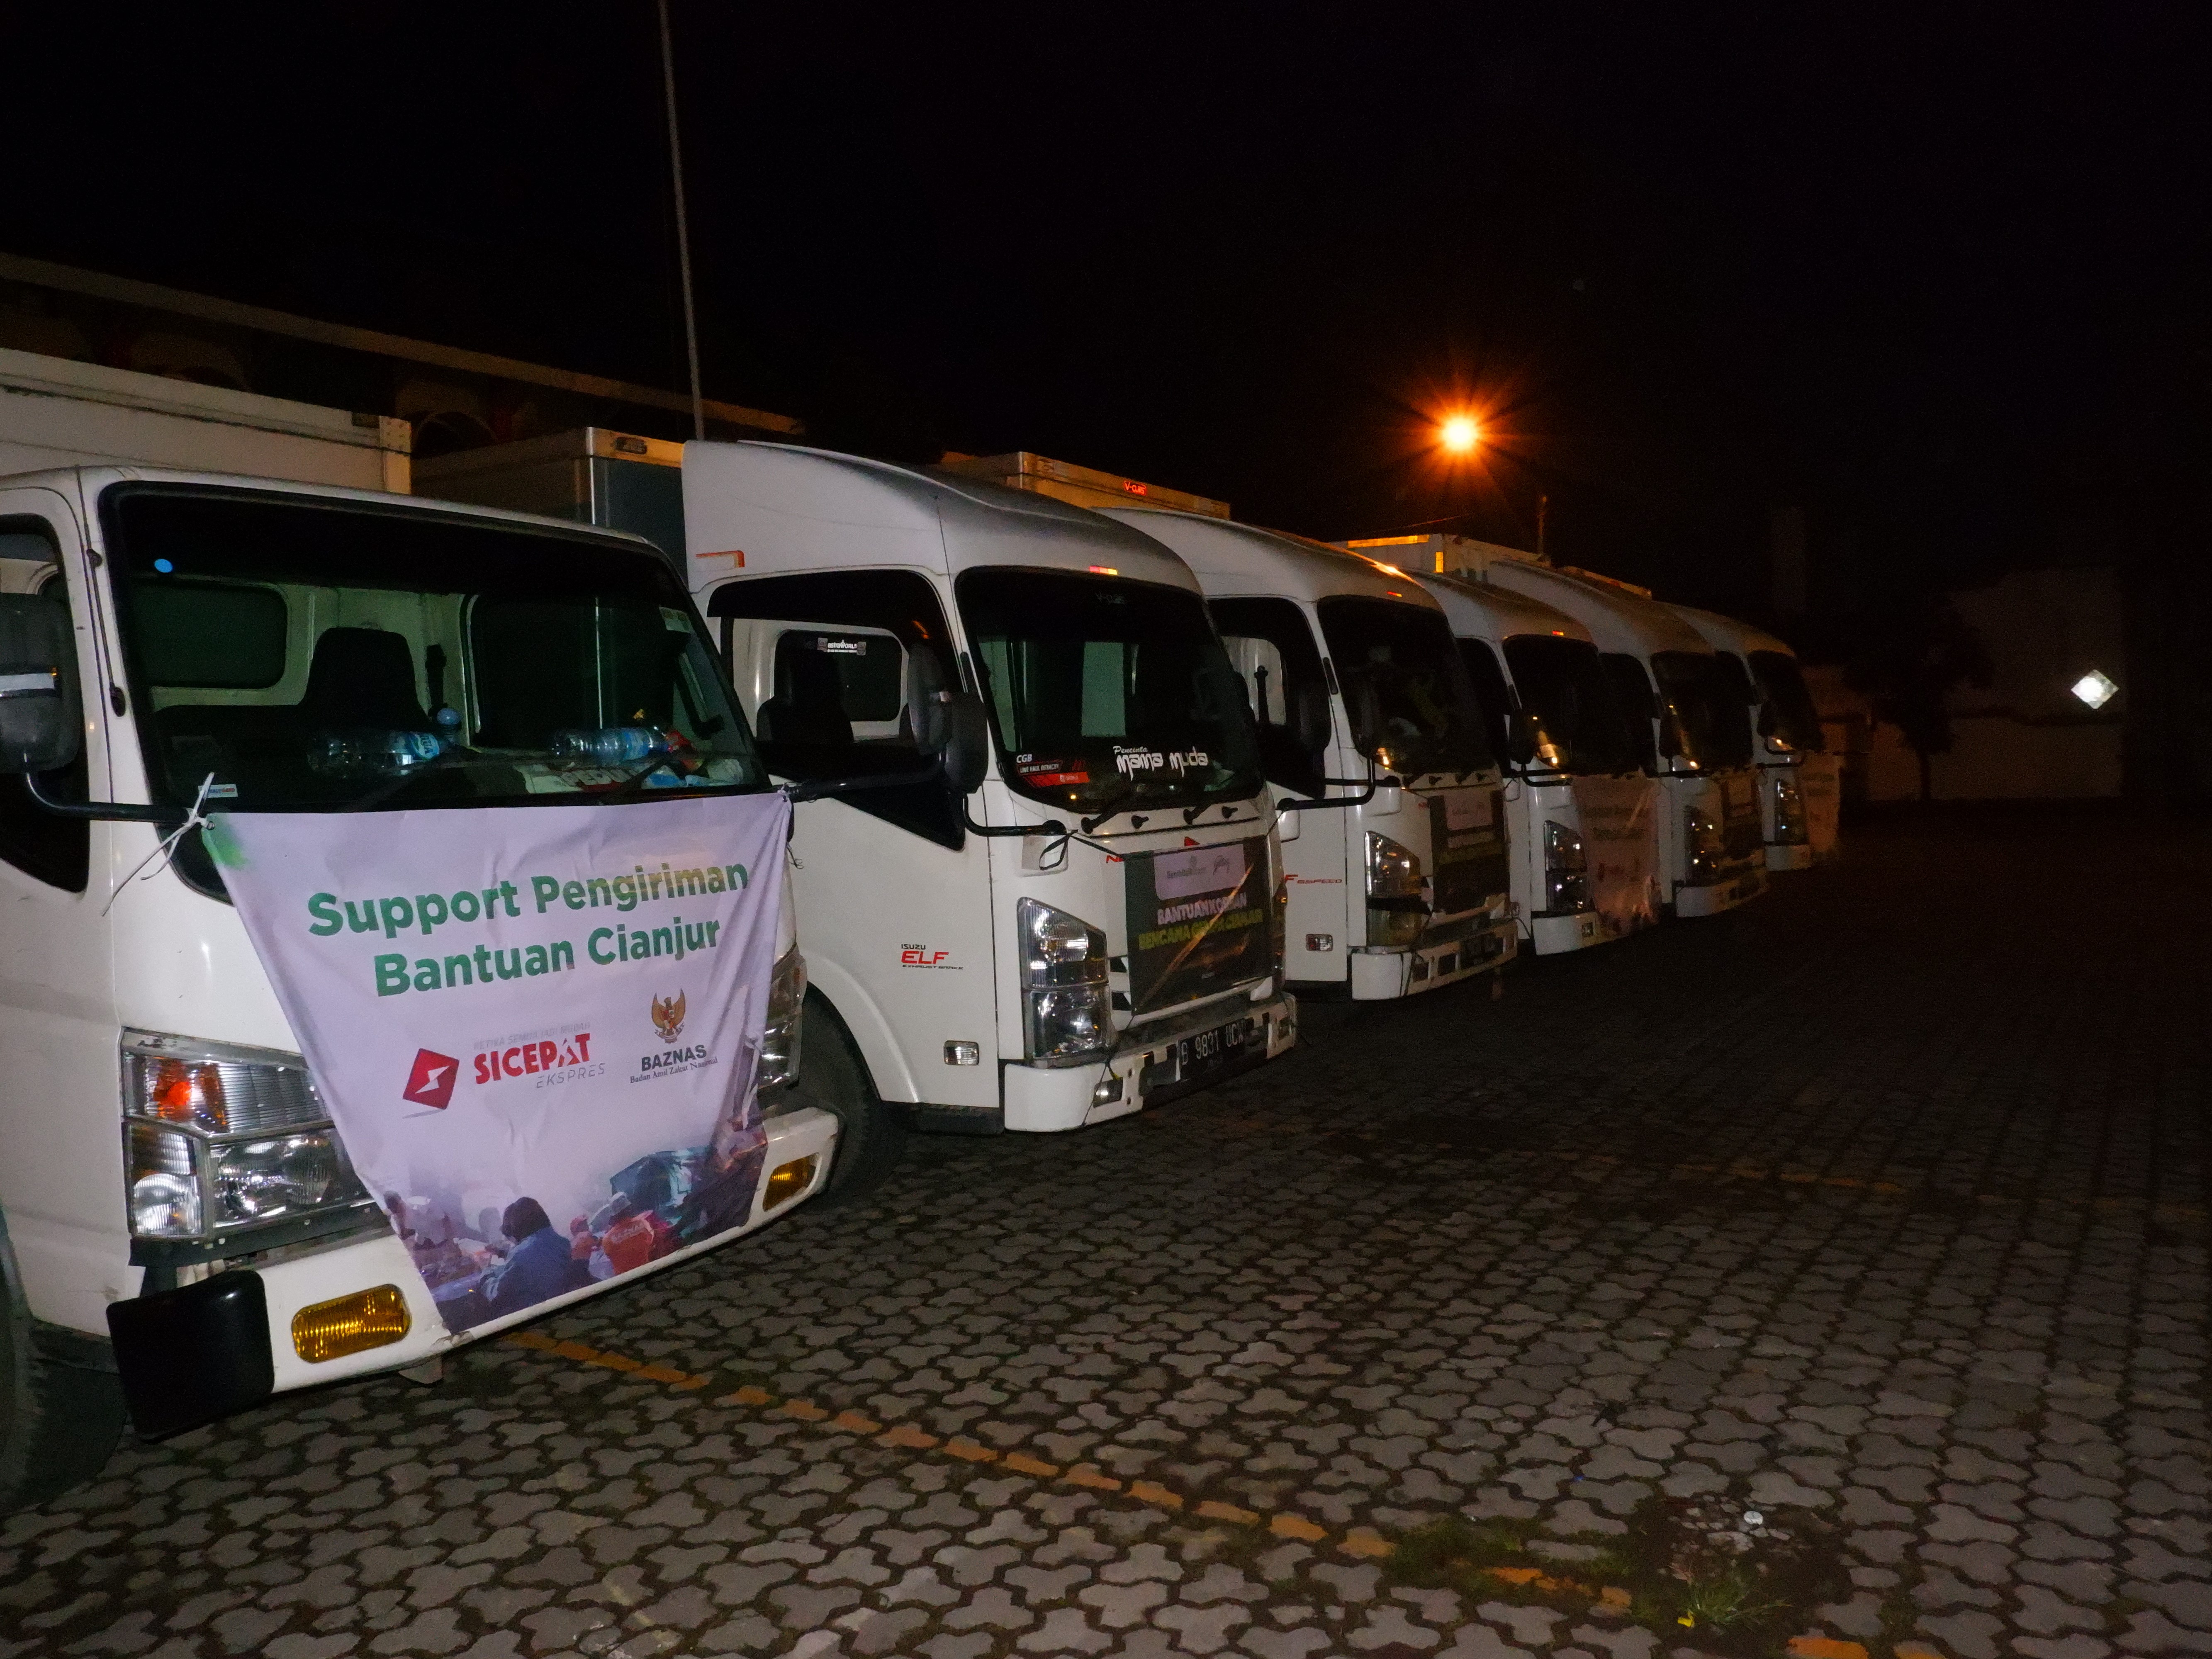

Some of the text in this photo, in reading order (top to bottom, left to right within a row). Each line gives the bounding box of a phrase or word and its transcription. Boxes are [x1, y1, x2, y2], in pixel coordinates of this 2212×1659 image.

[1016, 754, 1033, 764] CGB
[308, 862, 748, 939] Support Pengiriman
[374, 916, 720, 997] Bantuan Cianjur
[901, 951, 949, 964] ELF
[474, 1032, 591, 1085] SICEPAT
[642, 1044, 707, 1072] BAZNAS
[1195, 1030, 1219, 1060] 9831
[536, 1063, 606, 1089] EKSPRES
[630, 1057, 718, 1084] Badan Amil Zakat Nasional
